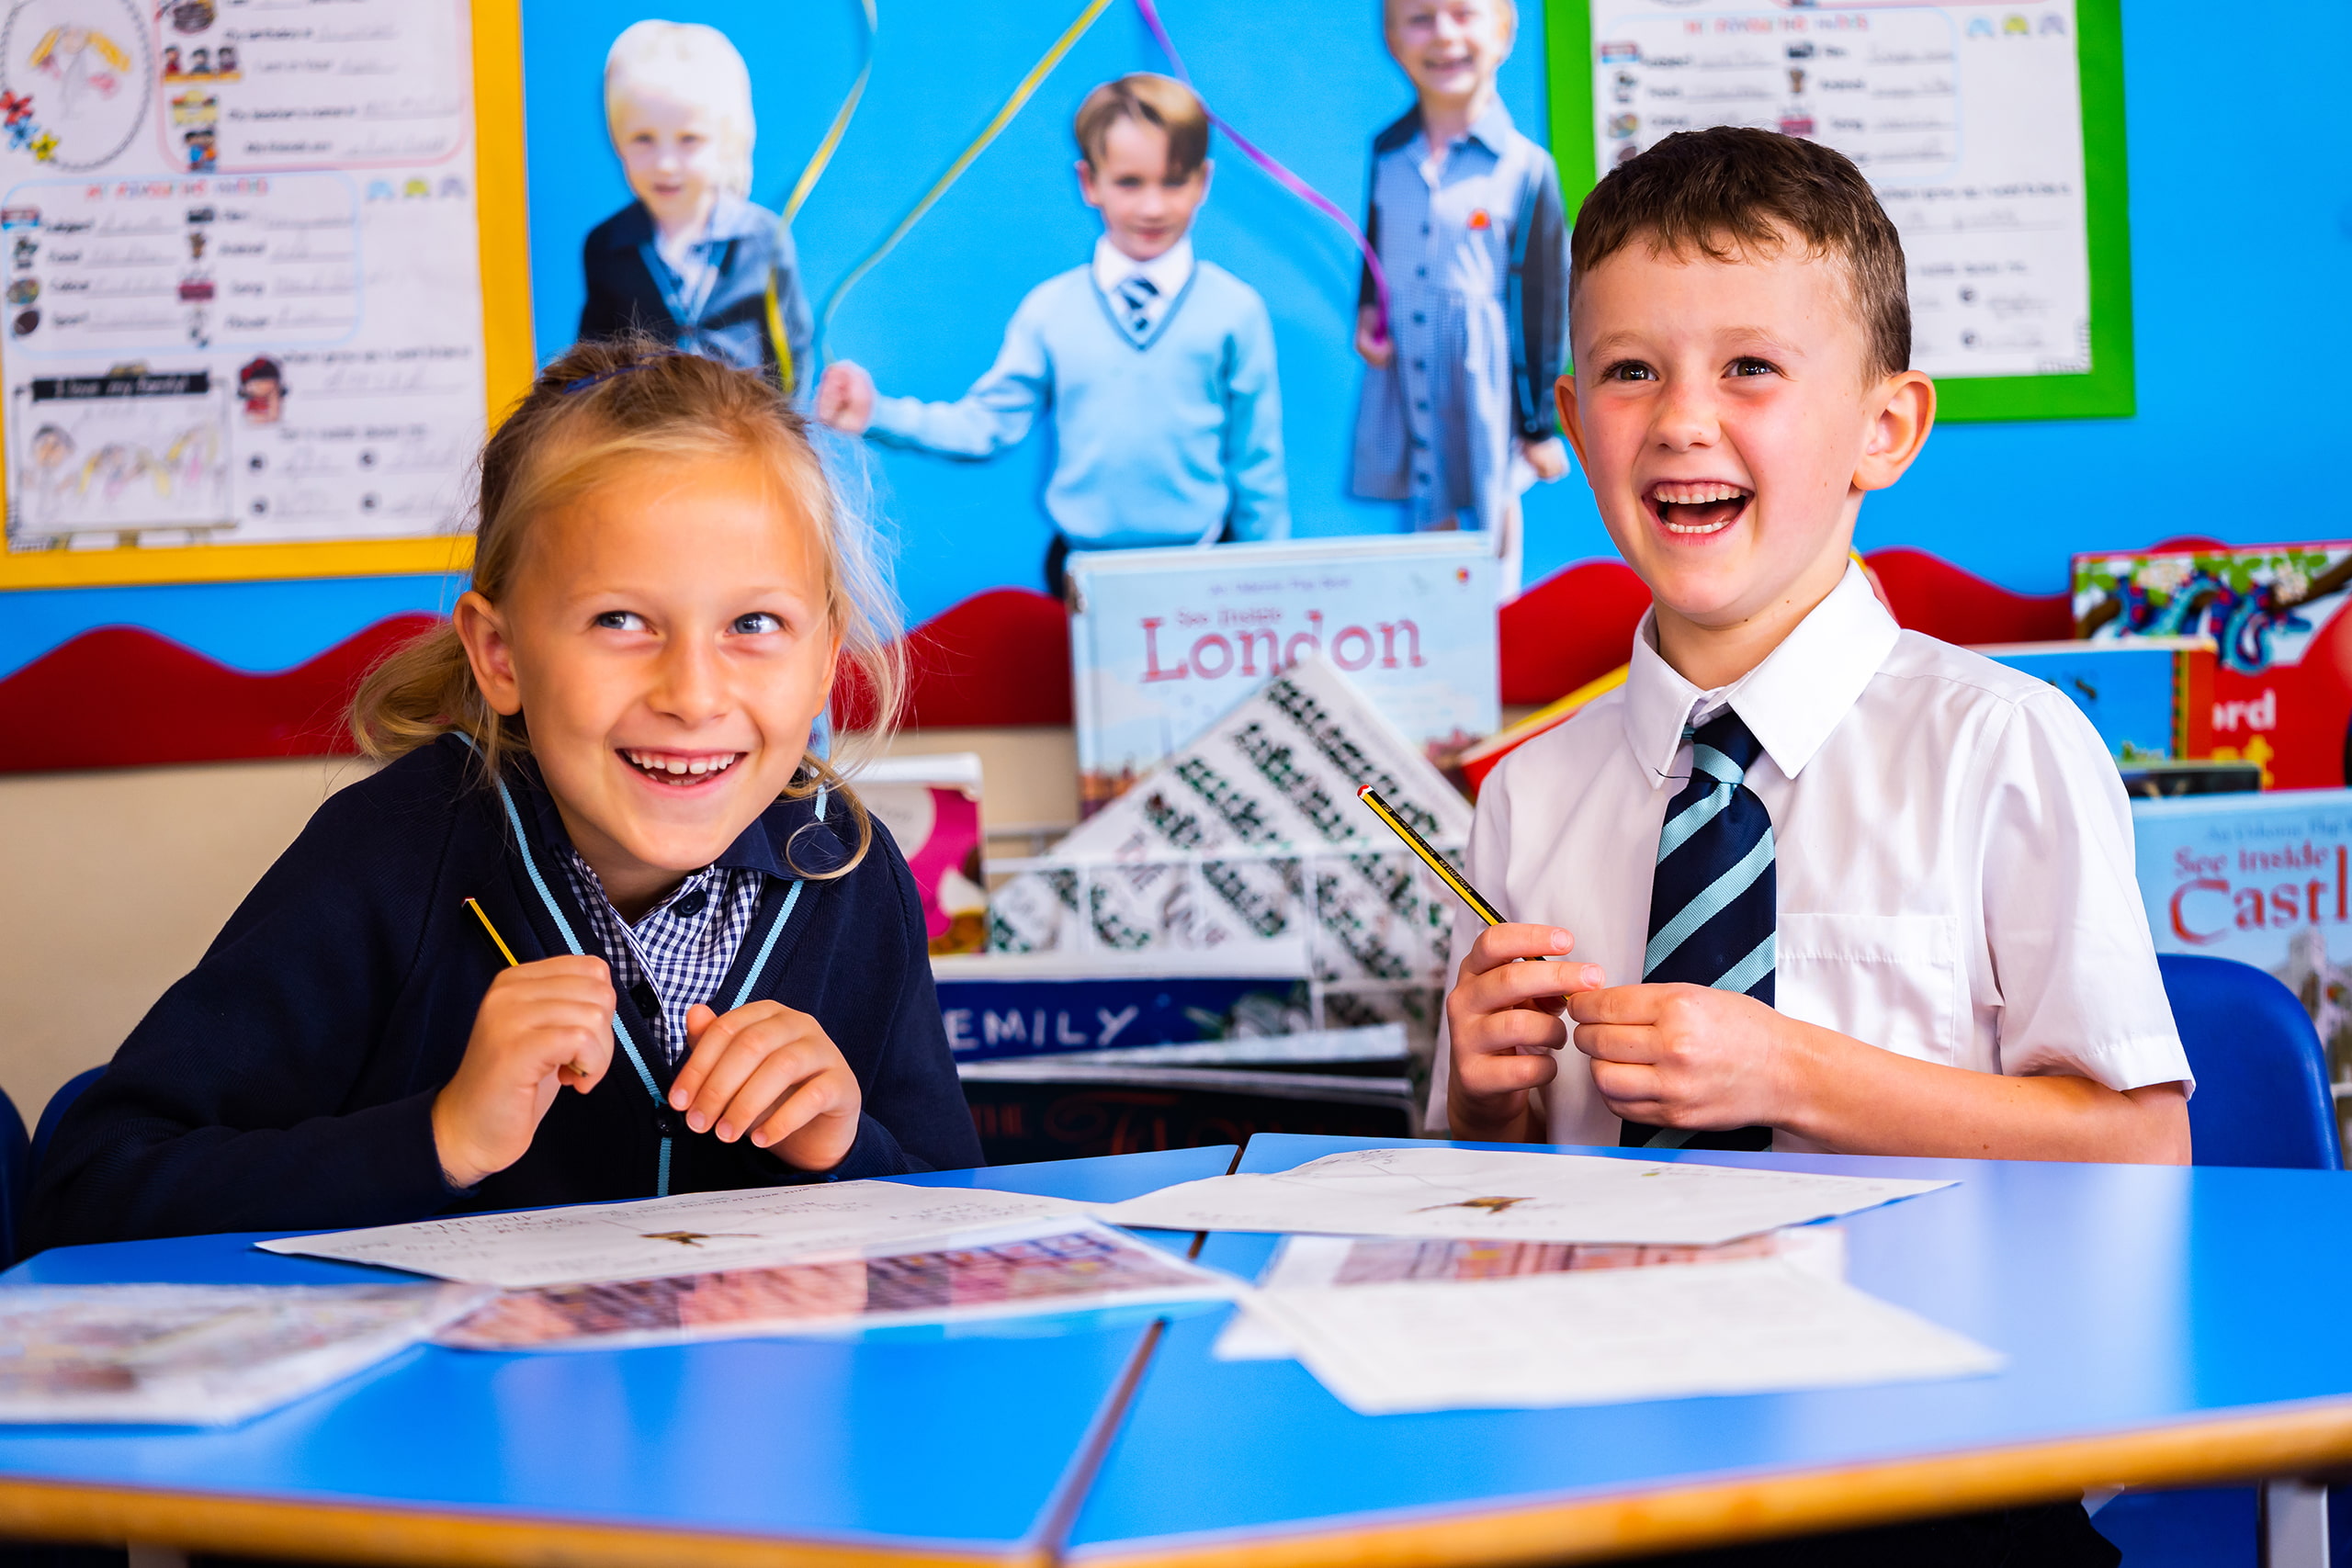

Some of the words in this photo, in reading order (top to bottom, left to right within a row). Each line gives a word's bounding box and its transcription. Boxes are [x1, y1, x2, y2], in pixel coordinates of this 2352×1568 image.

[1140, 609, 1427, 682] London
[2175, 846, 2228, 878] See
[943, 1005, 1139, 1051] EMILY
